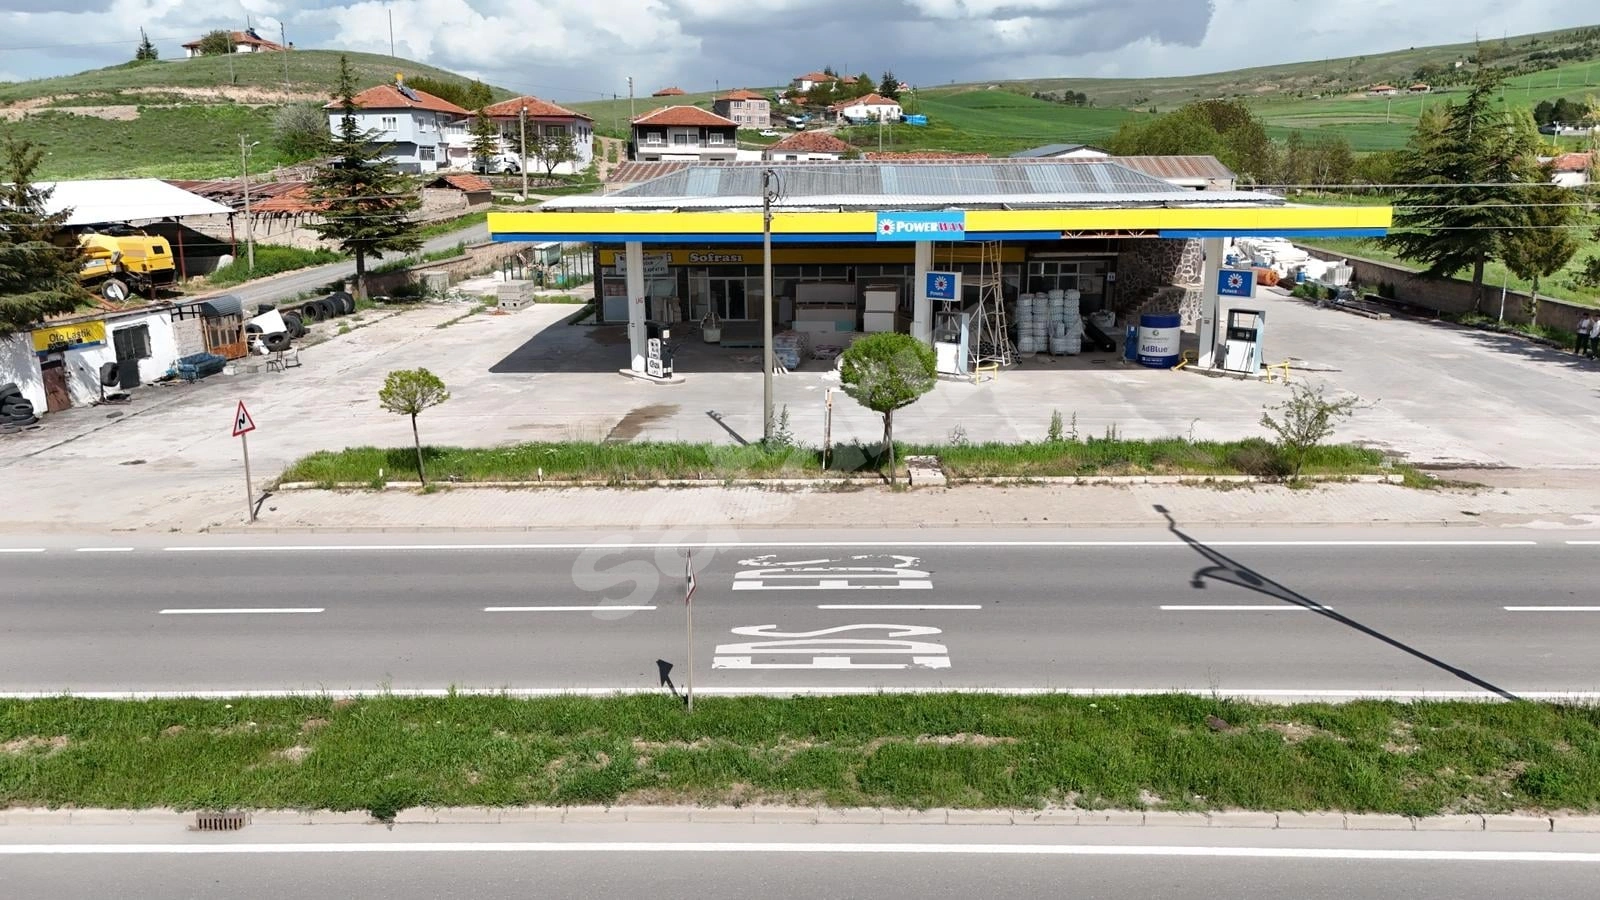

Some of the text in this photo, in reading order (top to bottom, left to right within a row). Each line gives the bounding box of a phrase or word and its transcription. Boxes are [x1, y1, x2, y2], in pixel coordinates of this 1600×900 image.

[689, 253, 743, 263] Sofrası
[49, 328, 92, 342] Oto Lastik
[1141, 345, 1168, 353] AdBlue
[711, 623, 952, 670] EDS
